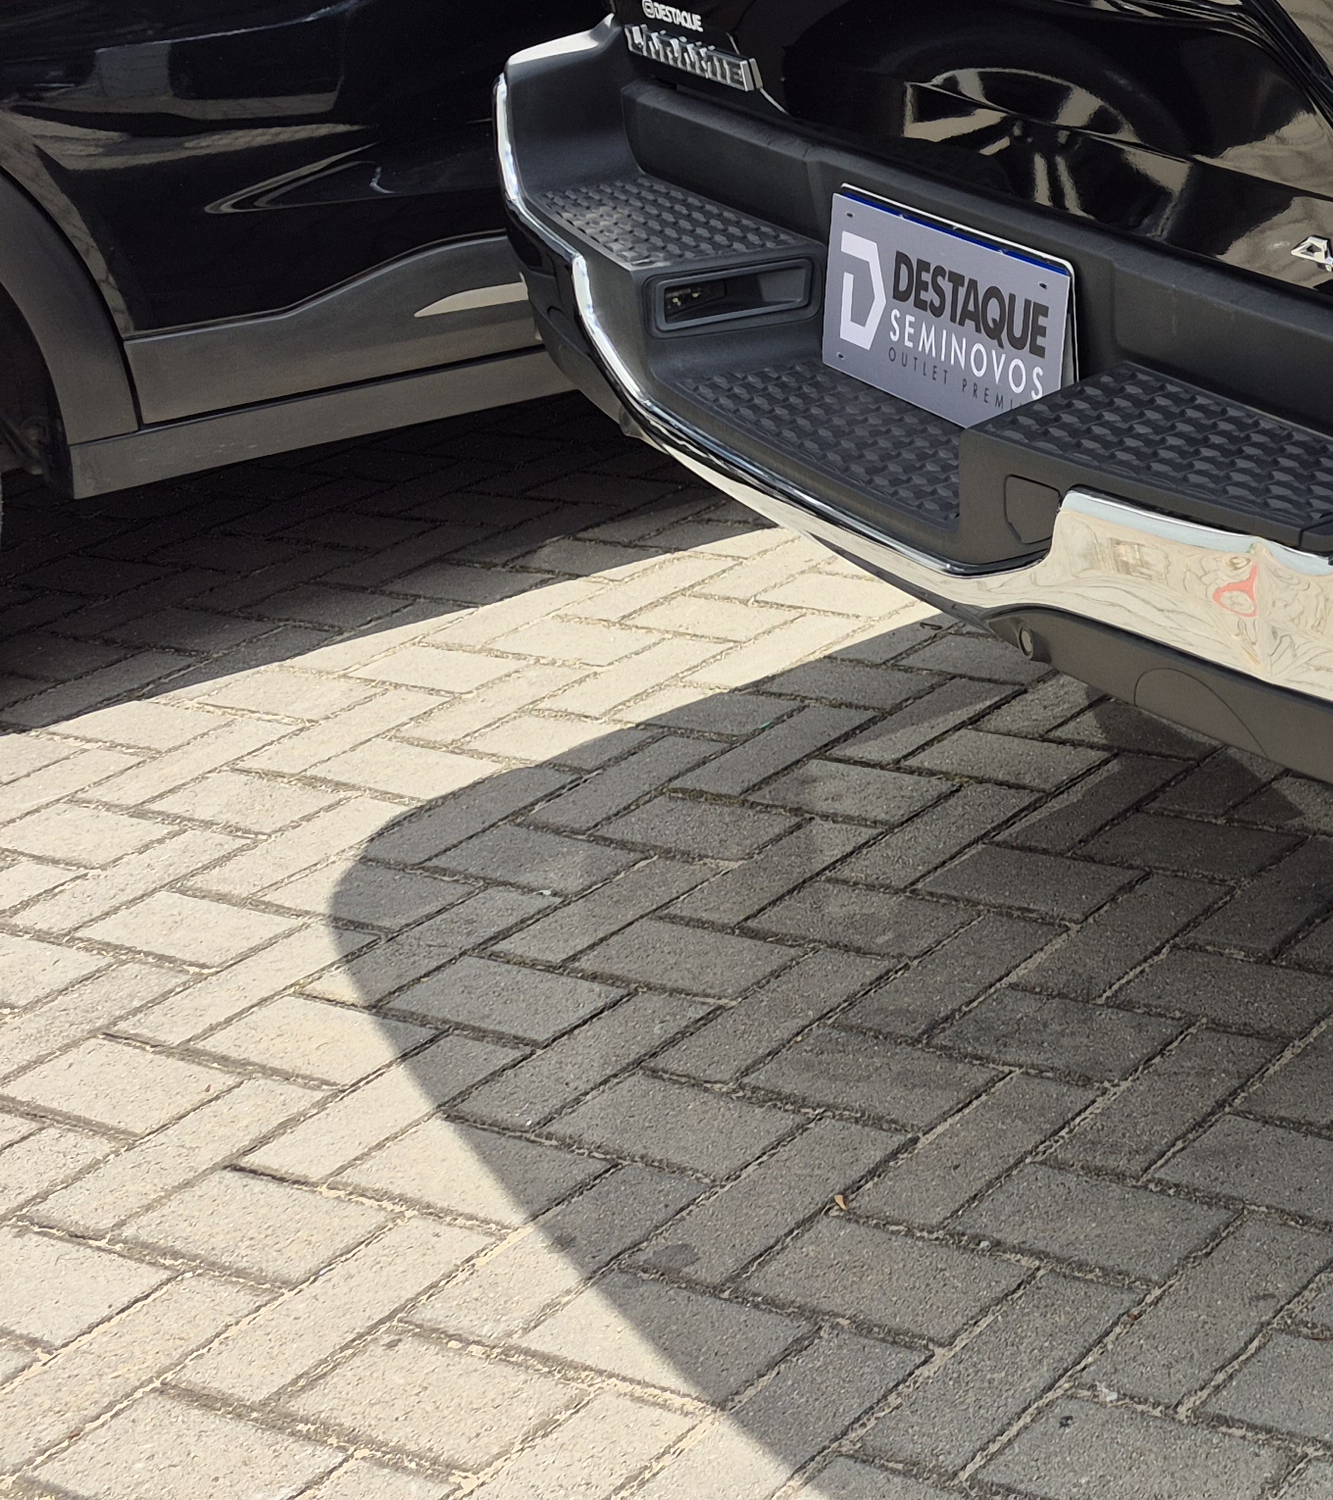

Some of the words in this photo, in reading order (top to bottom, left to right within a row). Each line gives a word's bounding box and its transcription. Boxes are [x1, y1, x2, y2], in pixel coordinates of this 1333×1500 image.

[653, 2, 704, 33] DESTAQUE
[892, 250, 1049, 359] DESTAQUE
[888, 308, 1044, 401] SEMINOVOS
[888, 346, 948, 385] OUTLET
[962, 378, 1023, 412] PREMI
